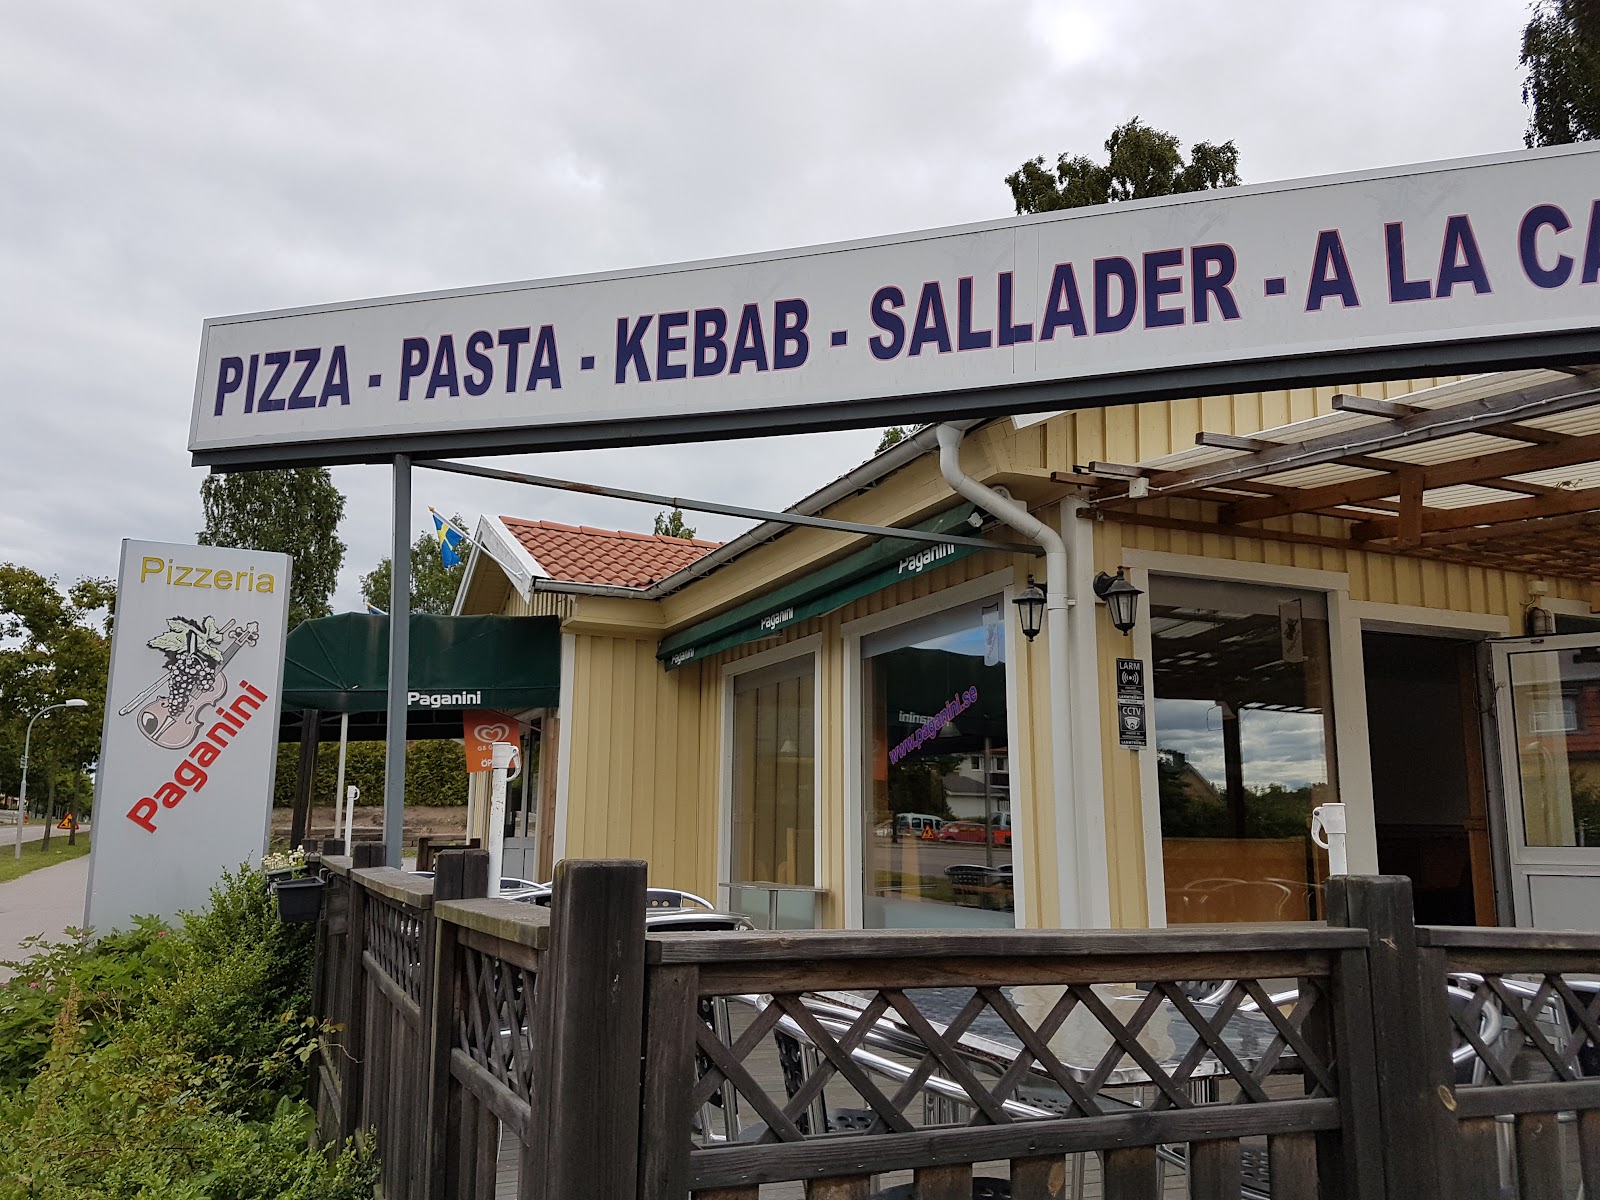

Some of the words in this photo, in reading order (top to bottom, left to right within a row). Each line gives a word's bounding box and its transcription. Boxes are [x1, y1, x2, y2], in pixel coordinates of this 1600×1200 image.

[213, 344, 351, 417] PIZZA
[397, 322, 563, 402] PASTA
[612, 296, 811, 386] KEBAB
[868, 241, 1242, 362] SALLADER
[1304, 227, 1362, 313] A
[1382, 213, 1495, 305] LA
[140, 556, 275, 593] Pizzeria
[898, 543, 955, 574] Paganini
[1119, 661, 1141, 671] LARM
[407, 690, 482, 708] Paganini
[1122, 706, 1141, 716] CCTV
[889, 686, 978, 765] www.paganini.se
[126, 679, 268, 833] Paganini
